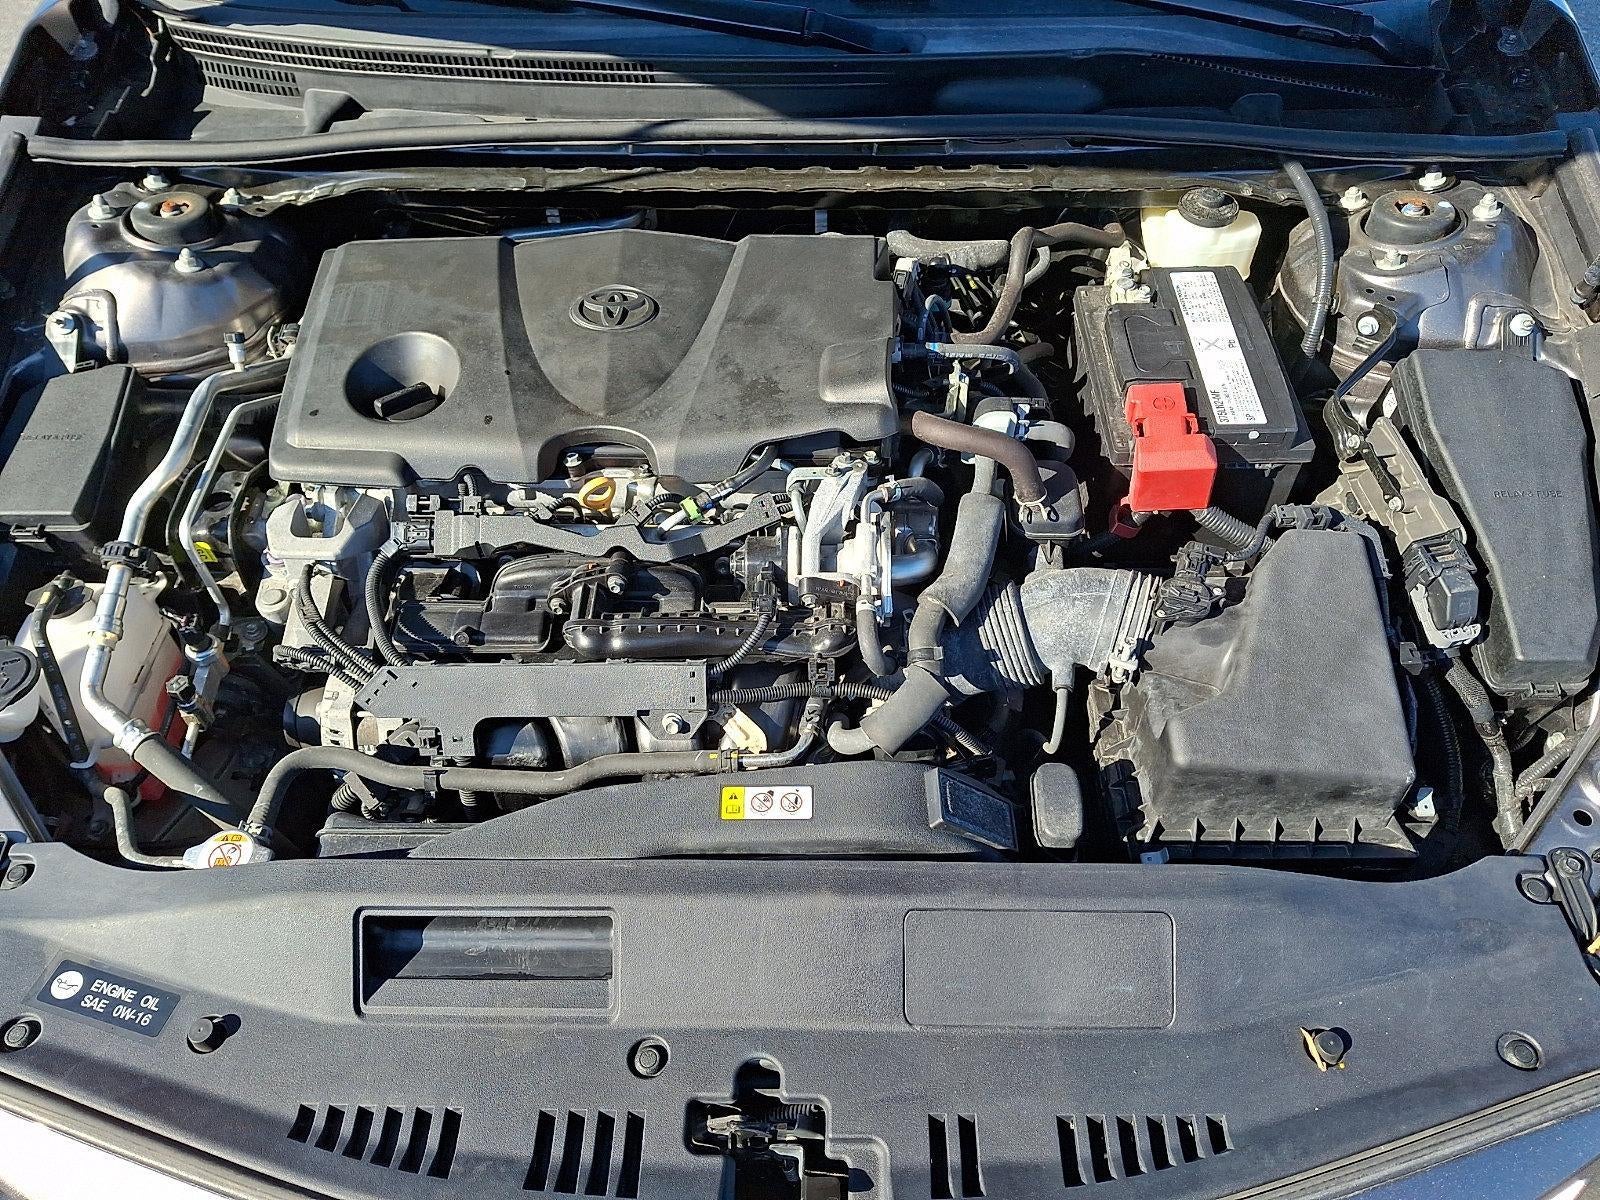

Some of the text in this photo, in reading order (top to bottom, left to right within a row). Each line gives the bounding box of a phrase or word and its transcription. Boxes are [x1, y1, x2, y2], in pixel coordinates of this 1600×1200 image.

[1493, 490, 1525, 498] RELAY
[1536, 490, 1564, 498] FUSE
[80, 994, 153, 1027] SAE 0W-16
[90, 979, 160, 1012] ENGINE OIL
